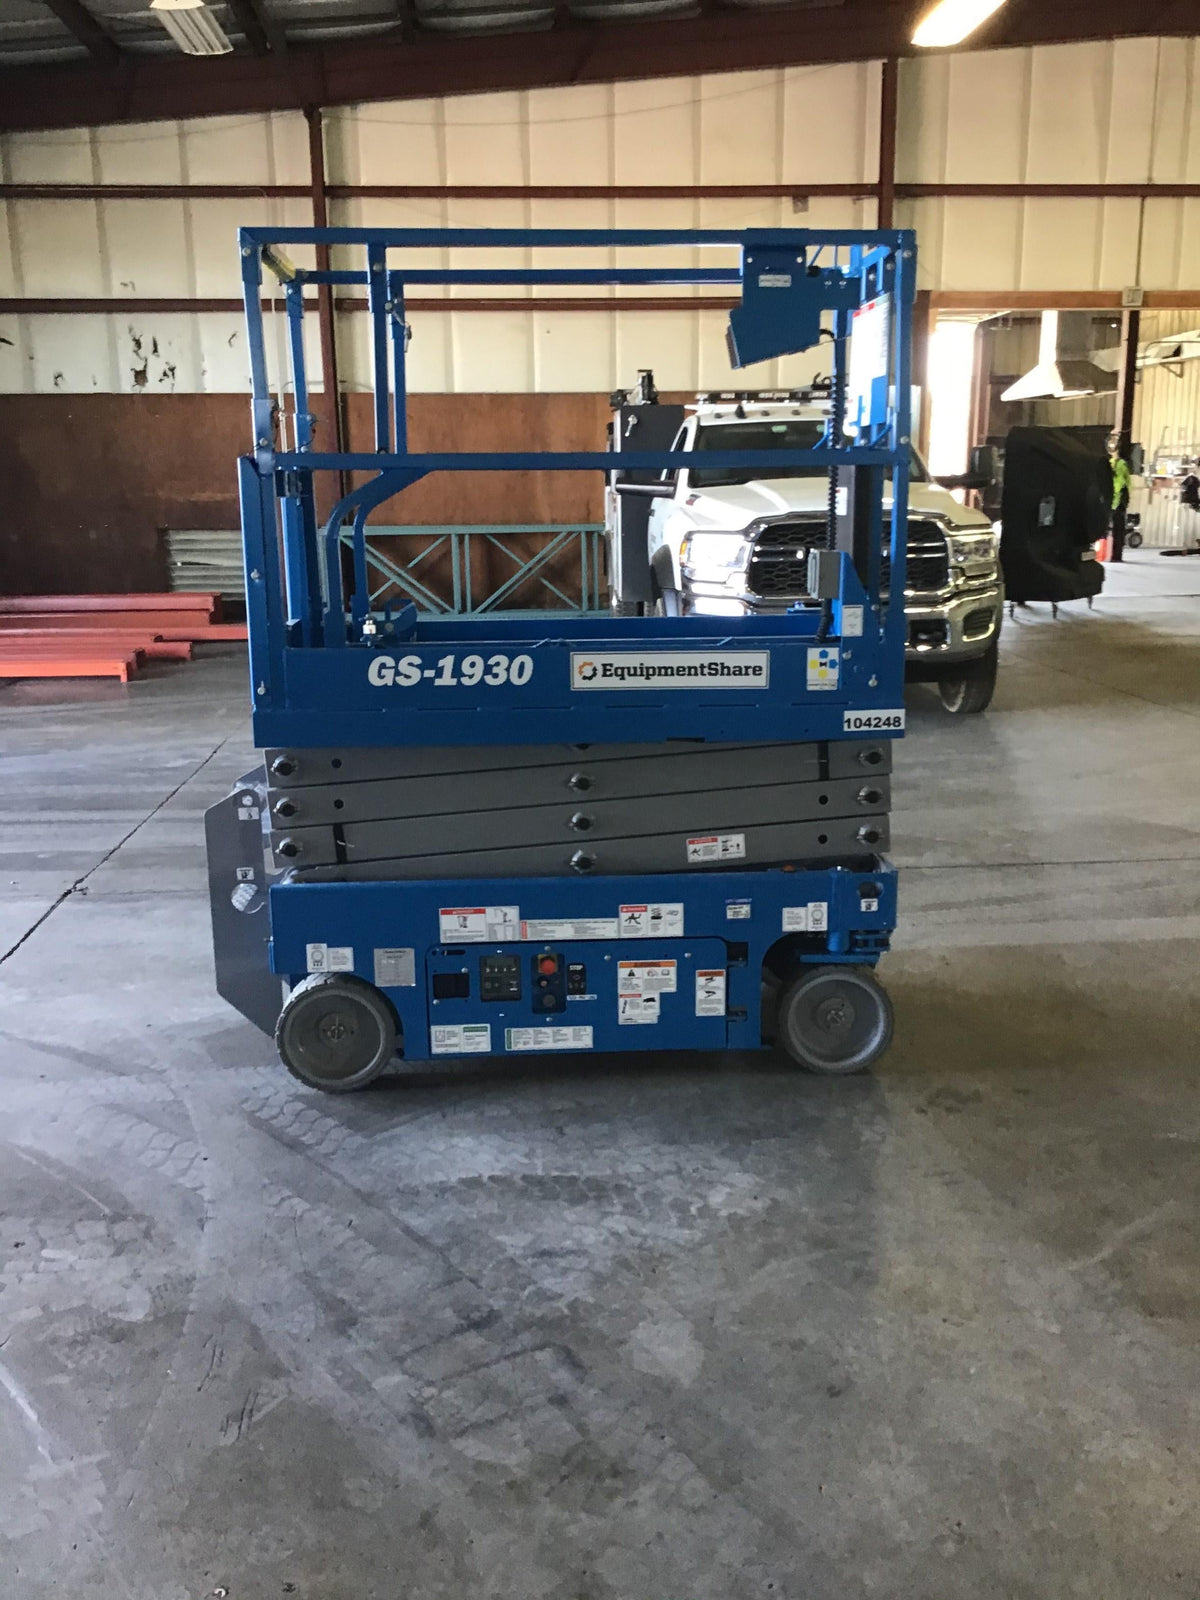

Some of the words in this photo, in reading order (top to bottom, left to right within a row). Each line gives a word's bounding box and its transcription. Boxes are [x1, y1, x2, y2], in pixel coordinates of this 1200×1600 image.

[367, 654, 534, 686] GS-1930
[601, 662, 763, 681] EquipmentShare
[844, 715, 902, 729] 104248
